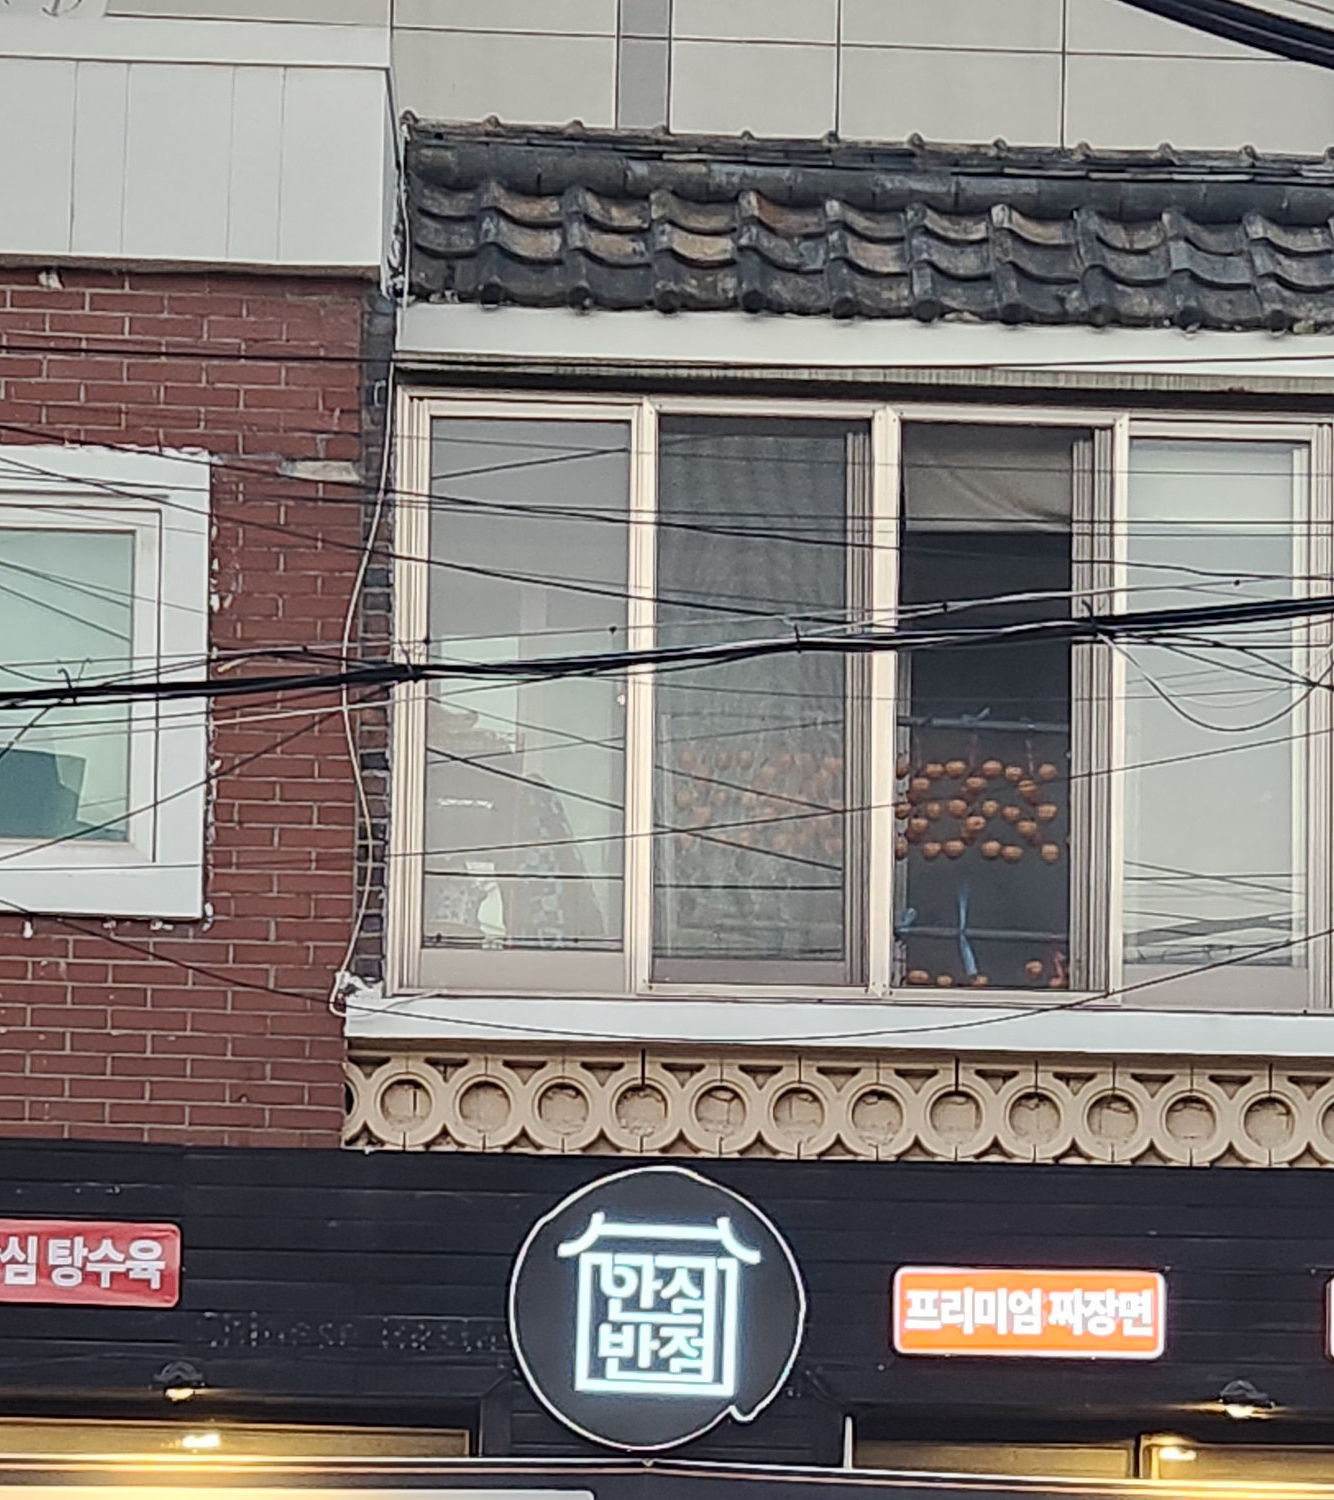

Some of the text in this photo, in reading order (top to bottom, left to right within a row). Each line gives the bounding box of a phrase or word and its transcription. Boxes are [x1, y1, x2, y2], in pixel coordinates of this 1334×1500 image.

[47, 1237, 166, 1289] 탕수육
[599, 1253, 709, 1324] 안심
[903, 1287, 1154, 1337] 프리미엄 짜장면
[599, 1323, 709, 1382] 반점
